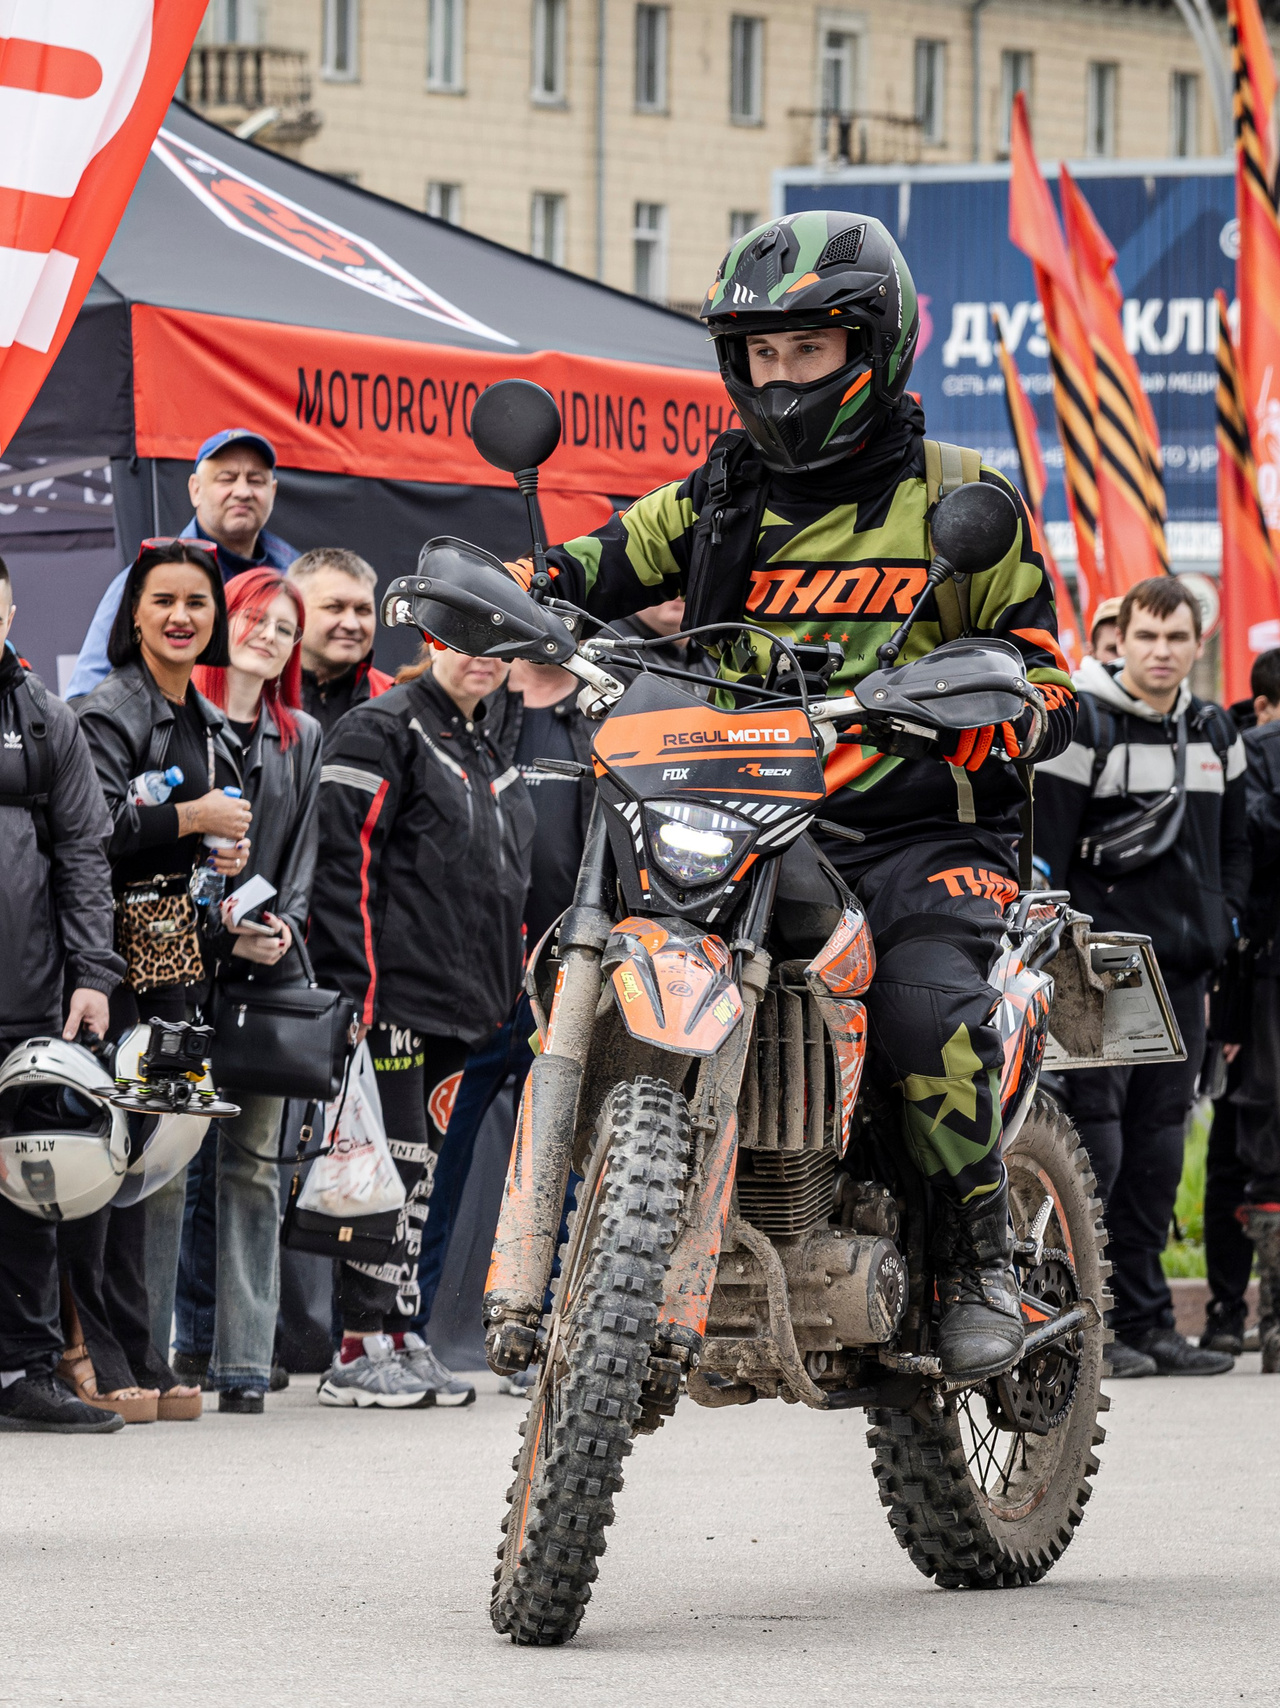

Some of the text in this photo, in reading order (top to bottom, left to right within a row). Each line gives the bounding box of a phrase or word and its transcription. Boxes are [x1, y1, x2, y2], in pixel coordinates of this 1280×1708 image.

[297, 367, 488, 440] MOTORCYC
[549, 388, 646, 453] IDING
[745, 566, 928, 615] THOR
[663, 728, 790, 746] REGULMOTO
[662, 768, 690, 781] FOX
[15, 1140, 55, 1154] ATLNT
